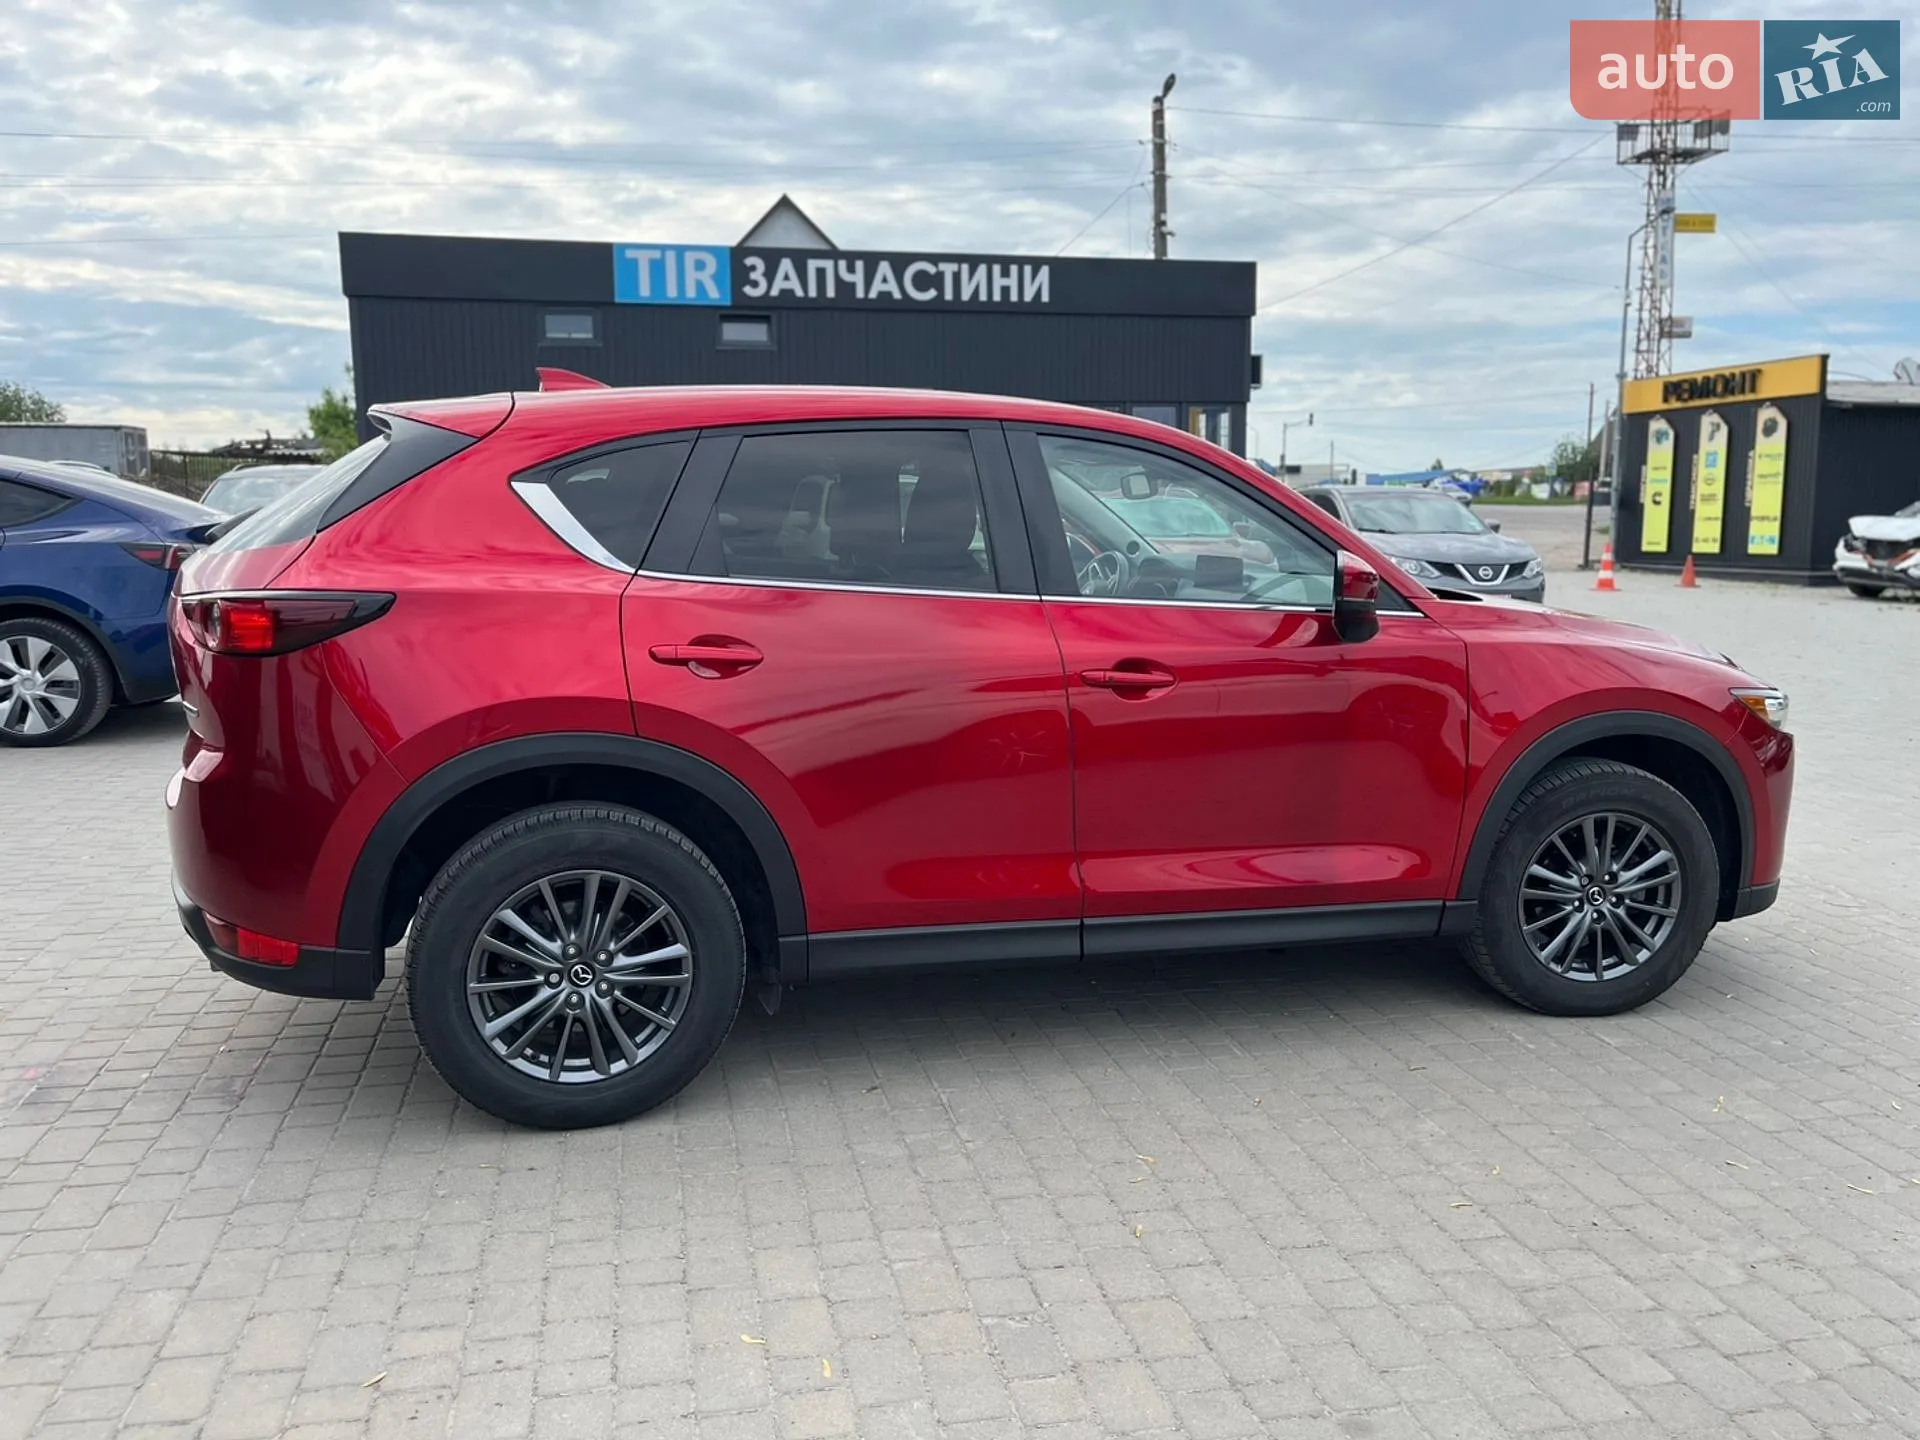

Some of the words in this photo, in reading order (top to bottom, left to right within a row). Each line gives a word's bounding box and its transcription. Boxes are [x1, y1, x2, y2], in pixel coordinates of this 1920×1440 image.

[625, 249, 721, 299] TIR
[742, 256, 1050, 303] ЗАПЧАСТИНИ
[1662, 368, 1763, 404] РЕМОНТ
